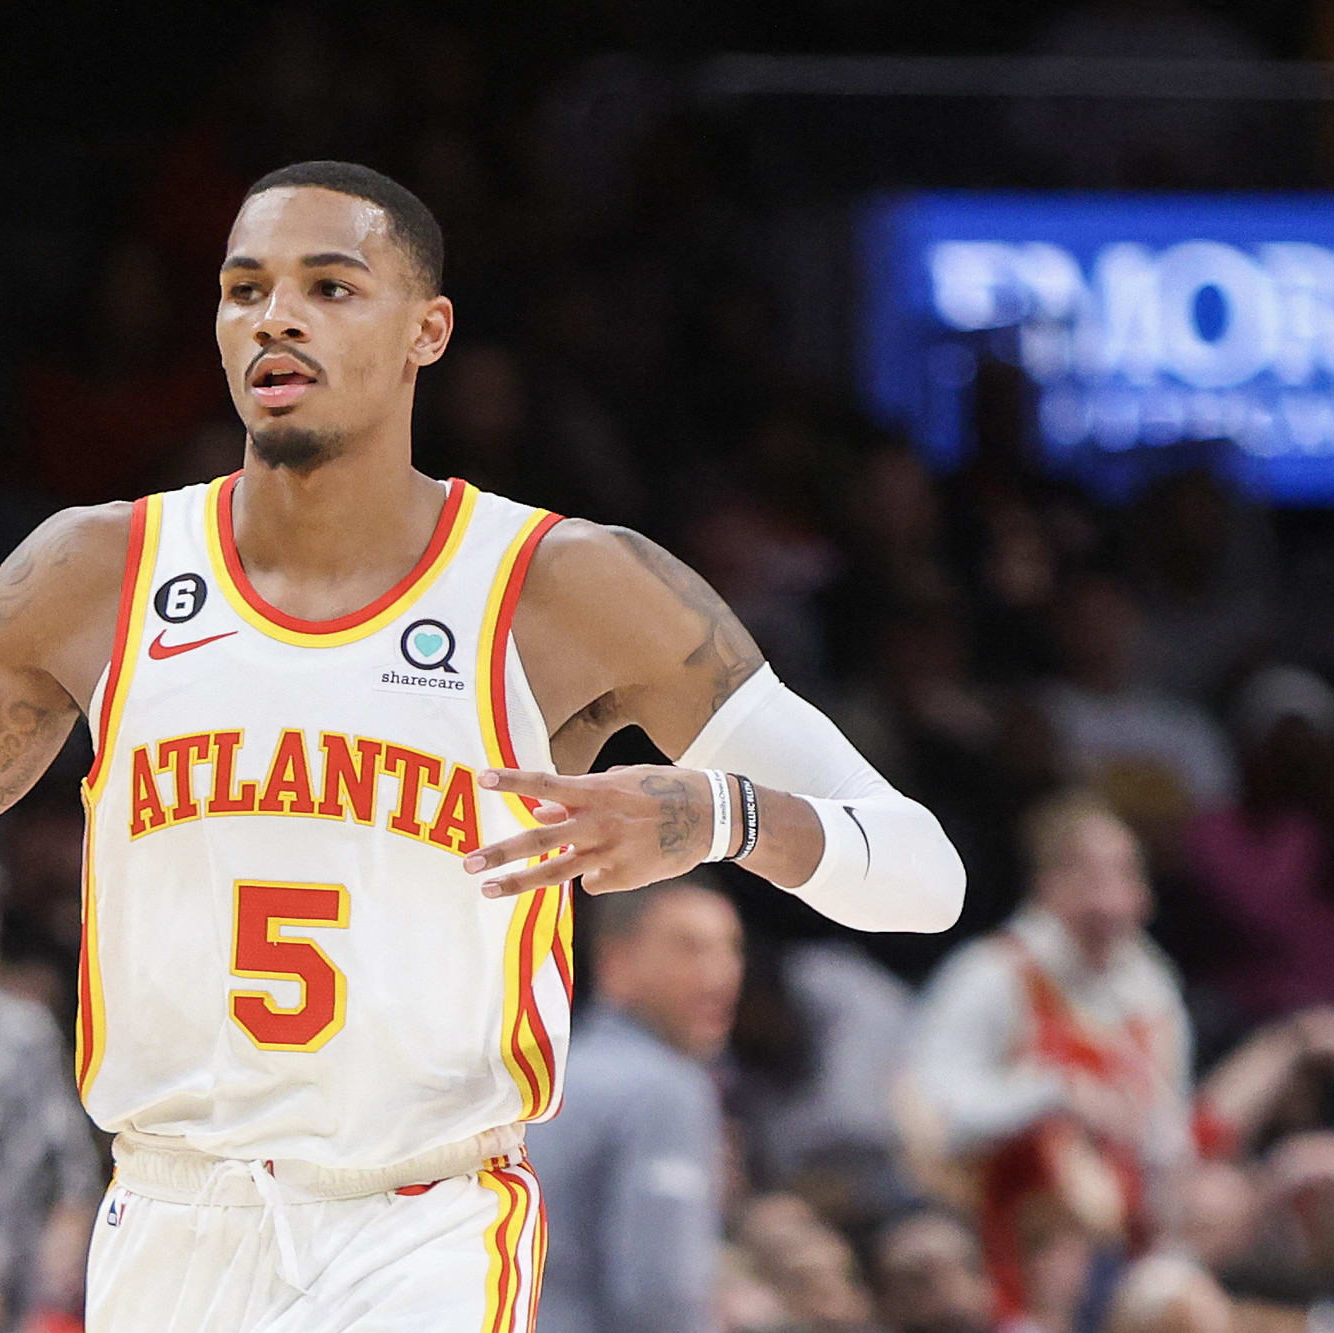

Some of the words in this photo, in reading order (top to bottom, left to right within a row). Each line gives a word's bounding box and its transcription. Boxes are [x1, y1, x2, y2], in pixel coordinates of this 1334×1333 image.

[165, 579, 197, 618] 6
[380, 670, 465, 691] sharecare
[129, 728, 484, 857] ATLANTA
[229, 879, 351, 1053] 5
